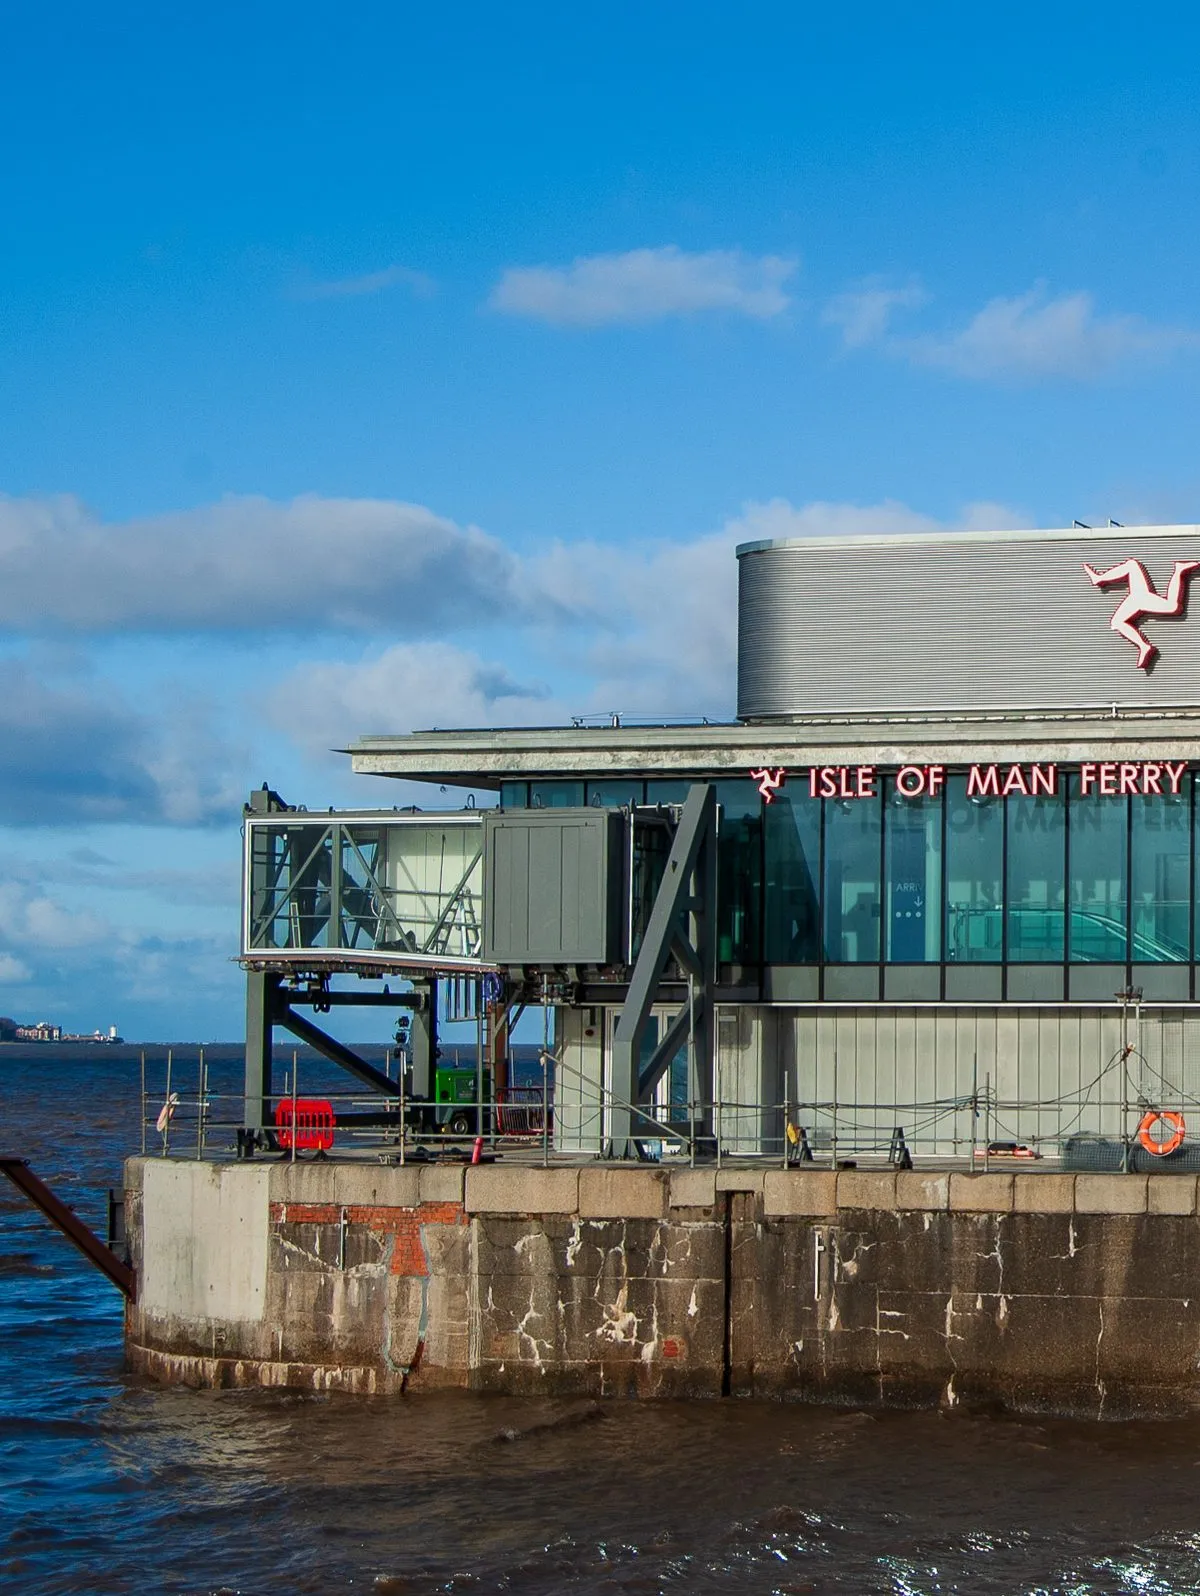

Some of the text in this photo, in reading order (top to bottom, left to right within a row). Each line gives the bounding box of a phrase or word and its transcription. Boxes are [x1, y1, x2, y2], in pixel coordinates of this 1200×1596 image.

[808, 766, 876, 798] ISLE
[895, 766, 945, 797] OF
[966, 764, 1057, 796] MAN
[1080, 762, 1188, 795] FERRY
